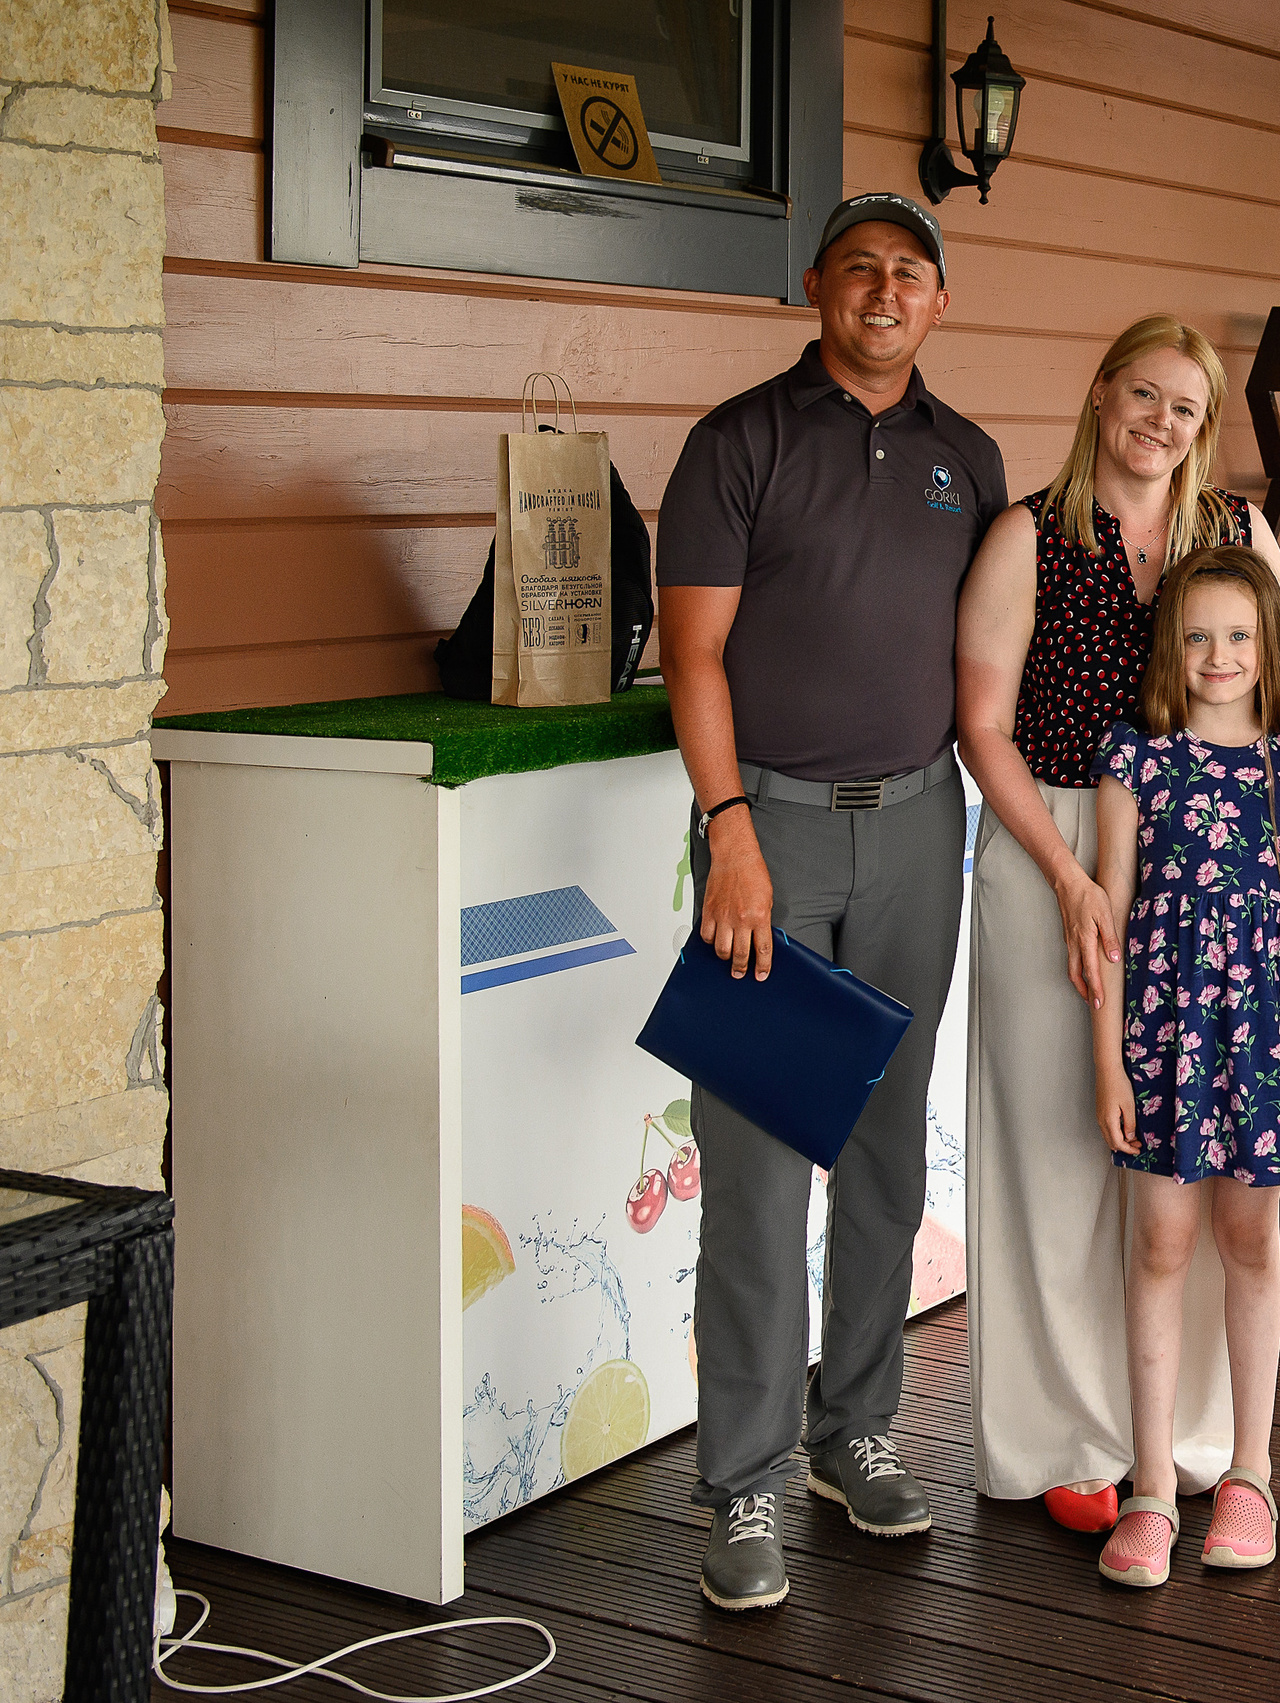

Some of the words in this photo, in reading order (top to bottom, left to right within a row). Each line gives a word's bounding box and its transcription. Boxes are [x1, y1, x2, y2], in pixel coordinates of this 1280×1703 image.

[562, 73, 568, 82] У
[570, 75, 589, 86] НАС
[591, 78, 602, 88] НЕ
[602, 80, 629, 93] КУРЯТ
[519, 490, 565, 513] HANDCRAFTED
[568, 496, 575, 506] IN
[578, 489, 600, 511] RUSSIA
[924, 488, 961, 506] GORKI
[521, 574, 557, 584] Особая
[559, 573, 602, 583] мягкость
[521, 584, 558, 592] БЛАГОДАРЯ
[561, 582, 603, 590] БЕЗУГОЛЬНОЙ
[521, 597, 602, 612] SILVERHORN
[521, 617, 541, 648] БЕЗ
